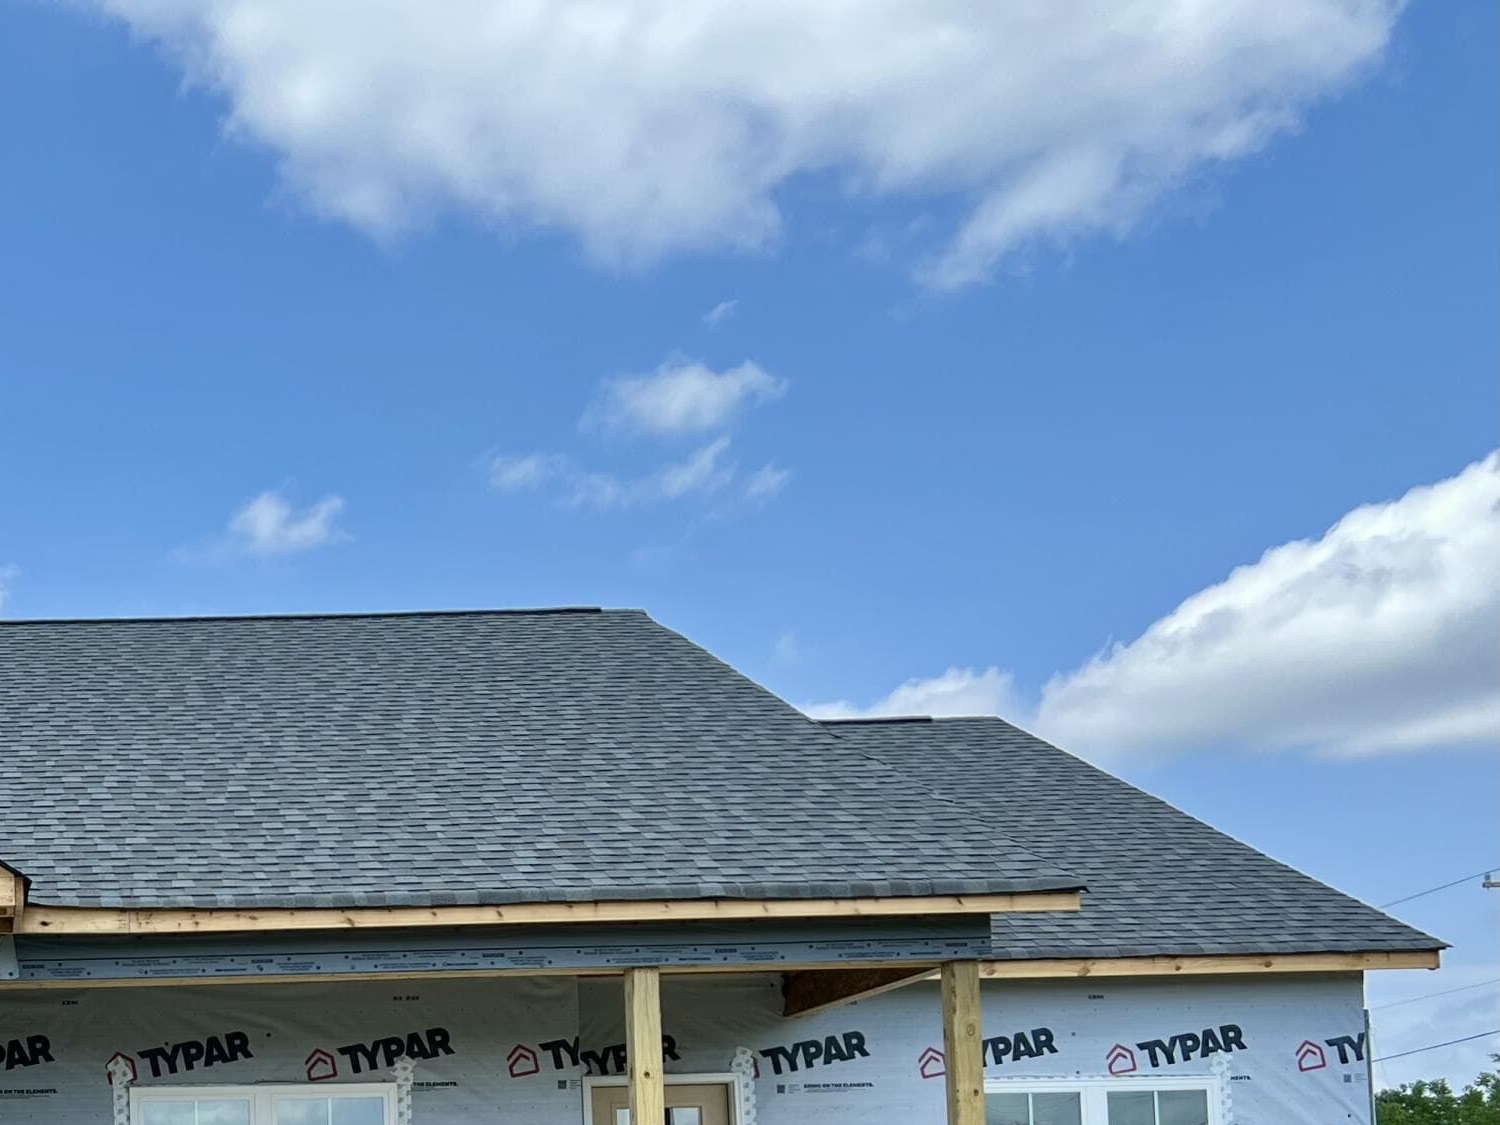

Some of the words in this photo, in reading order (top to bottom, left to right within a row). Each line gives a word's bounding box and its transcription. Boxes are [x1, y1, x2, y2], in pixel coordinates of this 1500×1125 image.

[137, 1030, 253, 1078] TYPAR
[337, 1027, 455, 1074] TYPAR
[759, 1030, 870, 1076] TYPAR
[982, 1027, 1059, 1068] PAR
[1136, 1024, 1247, 1068] TYPAR
